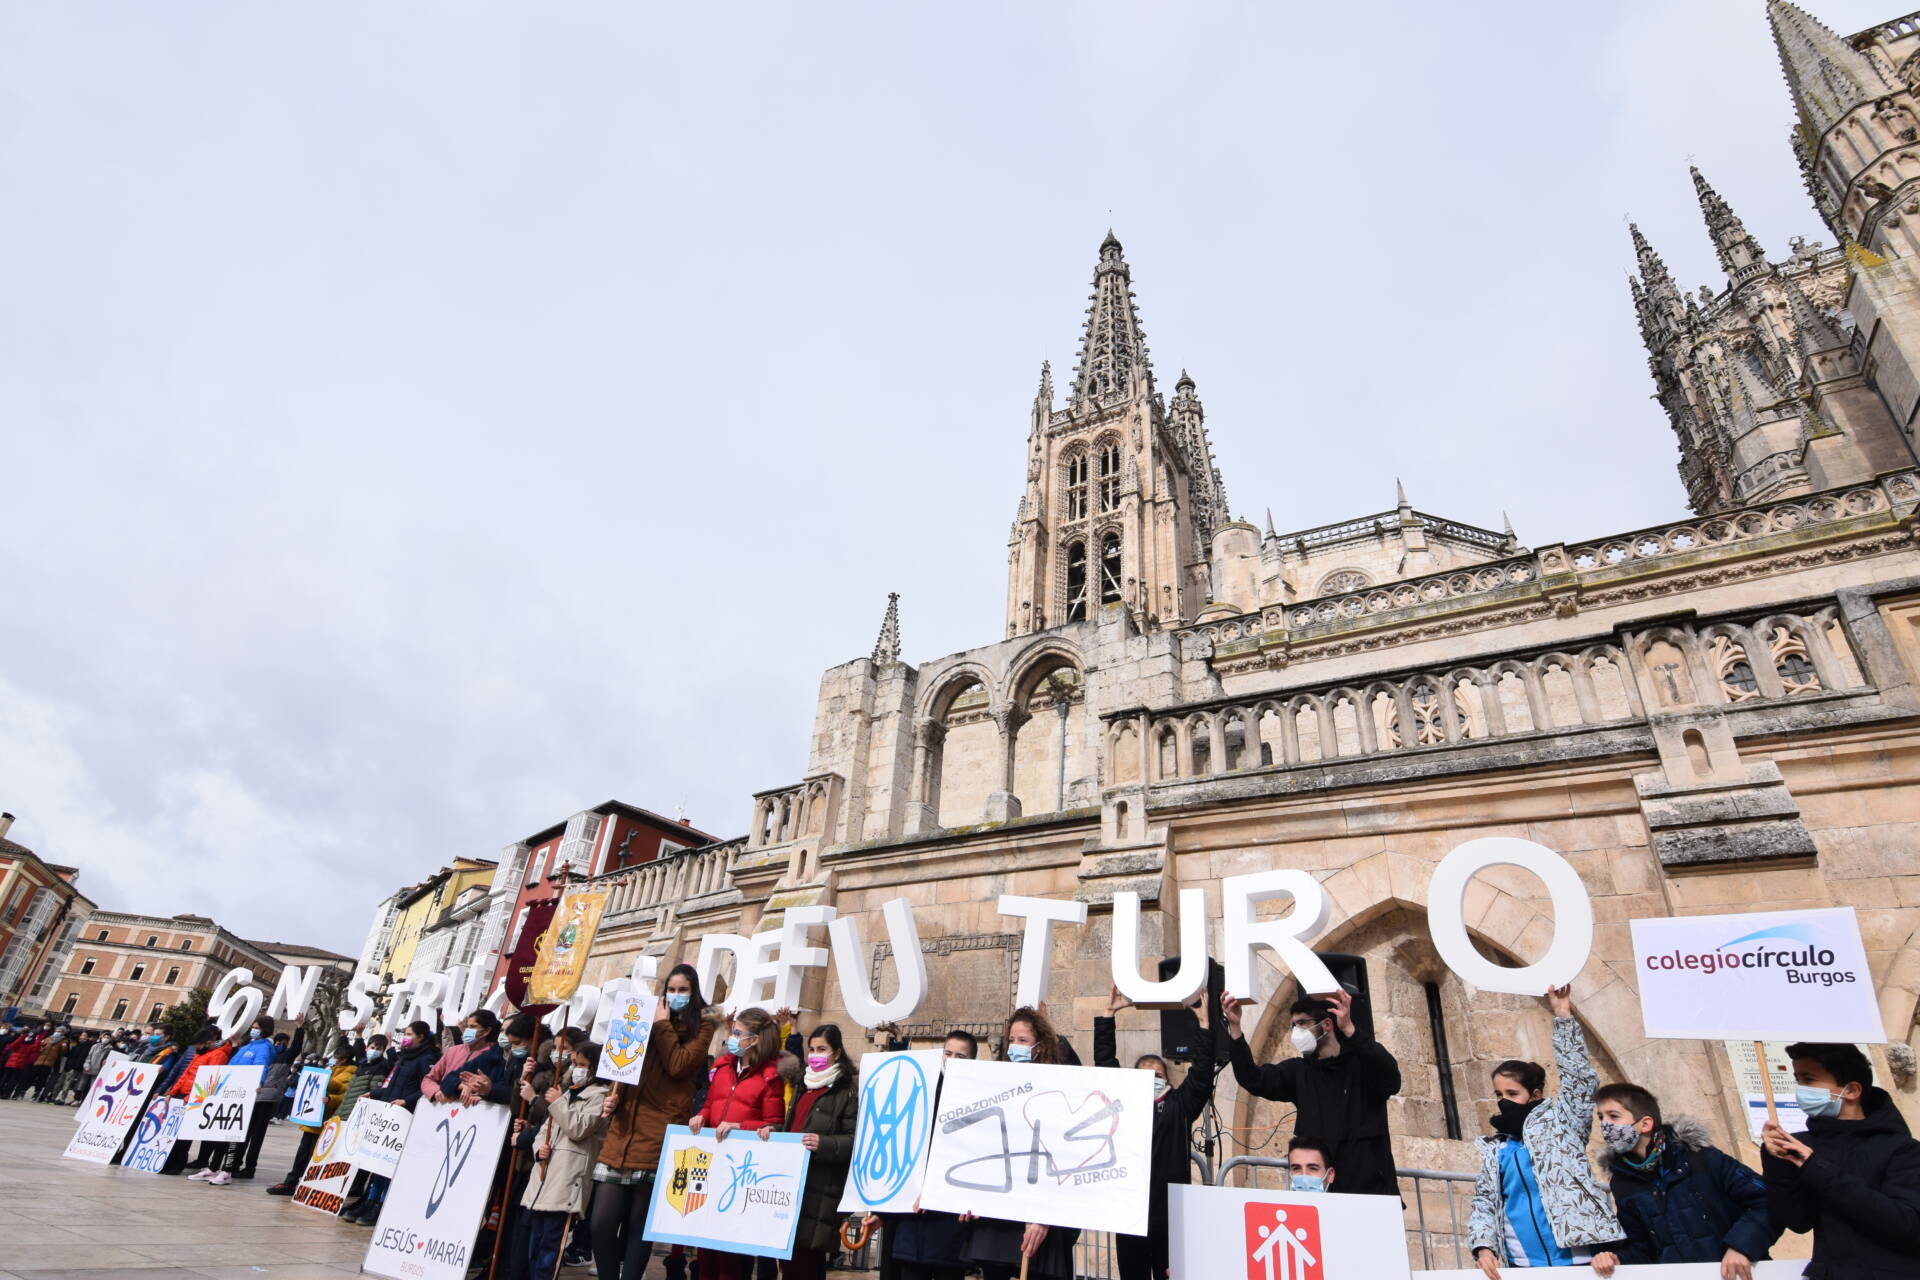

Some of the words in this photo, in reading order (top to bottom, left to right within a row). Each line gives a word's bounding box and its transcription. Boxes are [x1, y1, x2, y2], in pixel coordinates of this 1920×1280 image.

[1646, 945, 1835, 974] colegiocírculo
[1787, 968, 1856, 987] Burgos
[222, 1085, 247, 1099] familia
[938, 1082, 1034, 1124] CORAZONISTAS
[369, 1111, 401, 1134] Colegio
[1073, 1166, 1128, 1186] BURGOS
[375, 1227, 418, 1255] JESÚS
[423, 1238, 466, 1268] MARÍA
